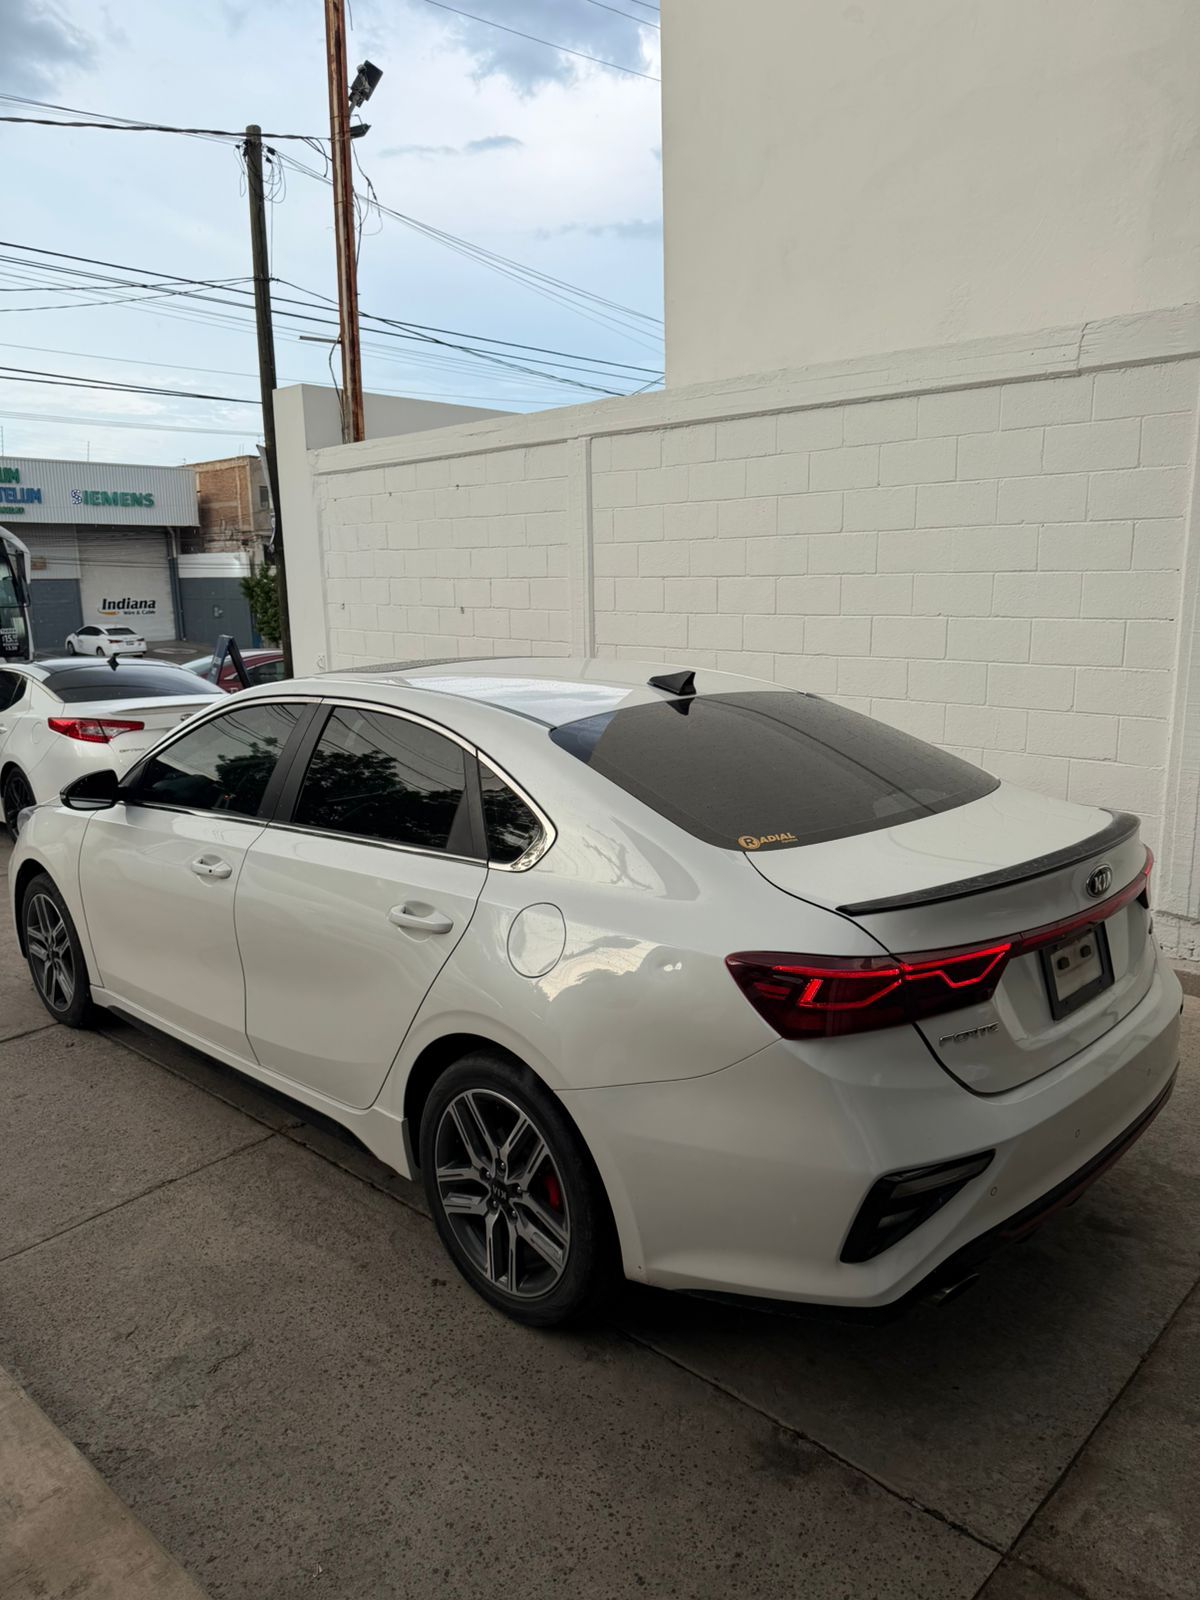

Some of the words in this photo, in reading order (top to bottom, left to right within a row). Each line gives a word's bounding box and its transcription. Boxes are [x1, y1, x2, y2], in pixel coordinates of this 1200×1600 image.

[71, 489, 155, 508] SIEMENS
[102, 597, 156, 610] Indiana
[738, 832, 796, 849] RADIAL
